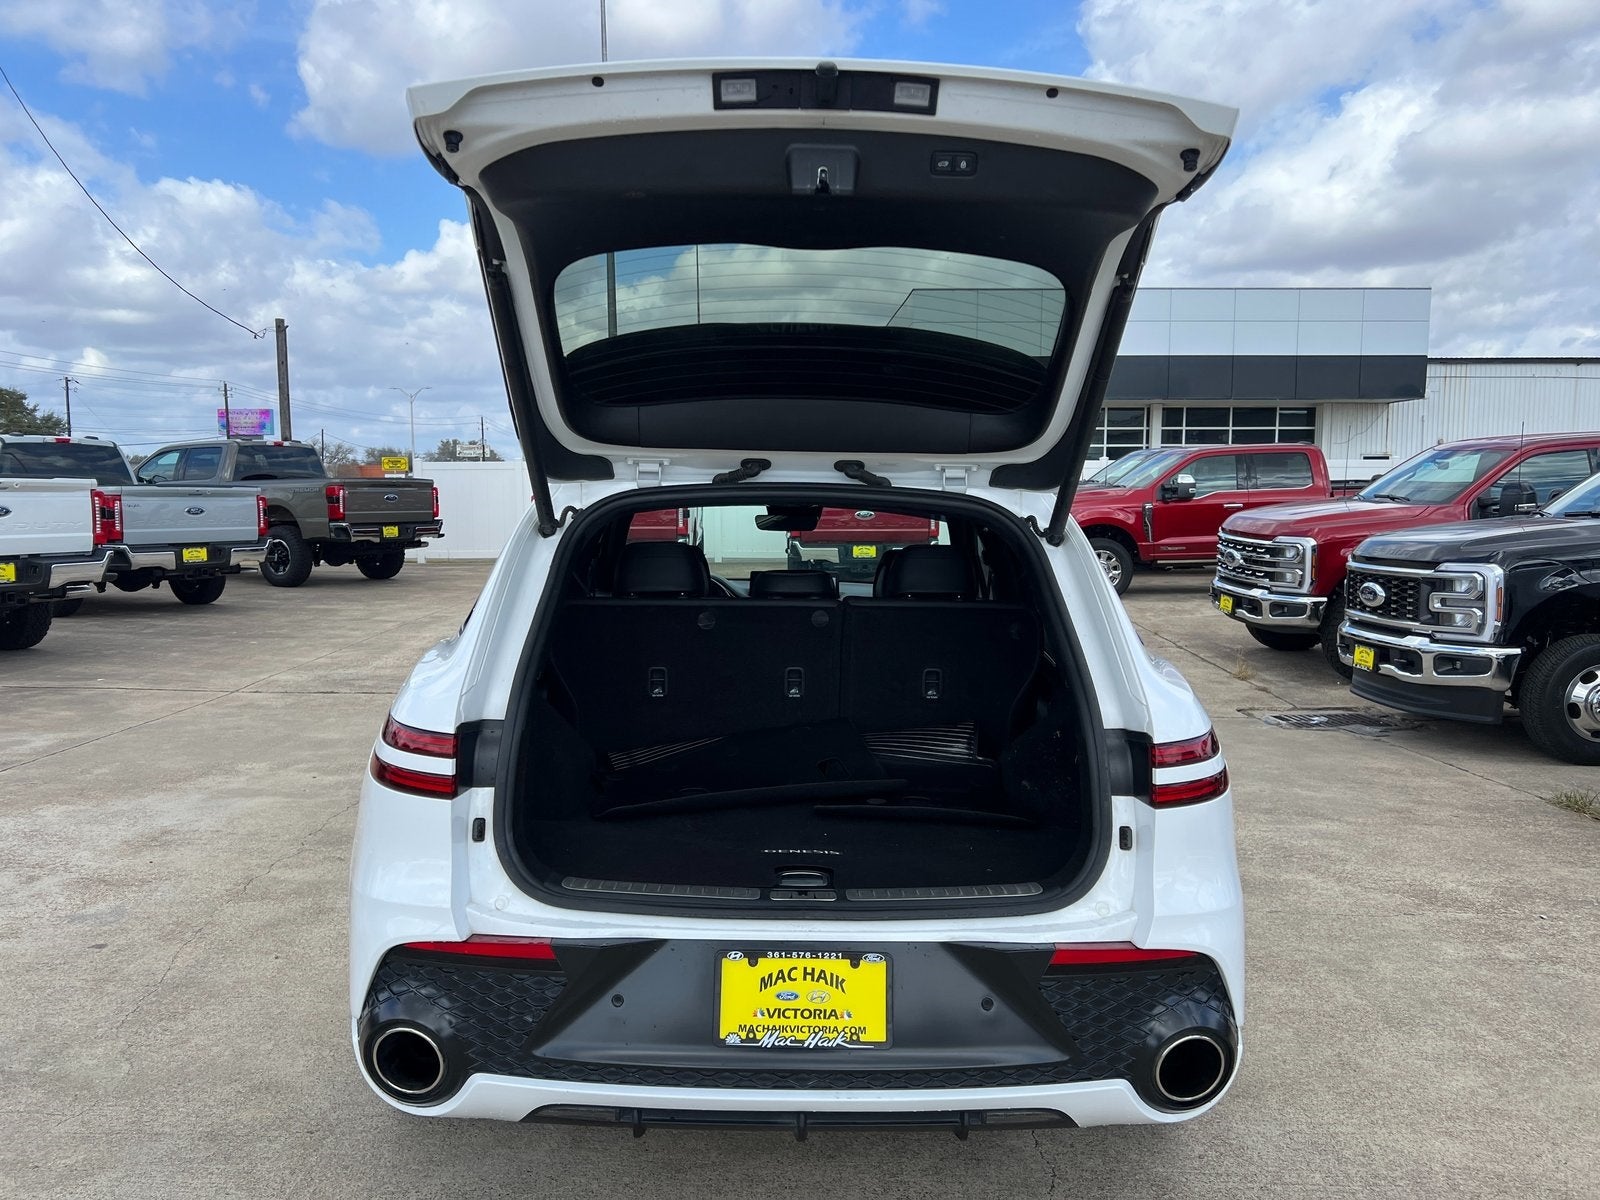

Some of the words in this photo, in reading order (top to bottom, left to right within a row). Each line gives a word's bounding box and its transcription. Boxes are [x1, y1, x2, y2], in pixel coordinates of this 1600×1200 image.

[767, 951, 843, 960] 361-576-1221
[759, 966, 798, 992] MAC
[802, 966, 847, 994] HAIK
[765, 1007, 839, 1020] VICTORIA
[738, 1024, 867, 1035] MACHAIKVICTORIA.COM
[757, 1029, 801, 1048] Mac
[802, 1030, 851, 1049] Haik
